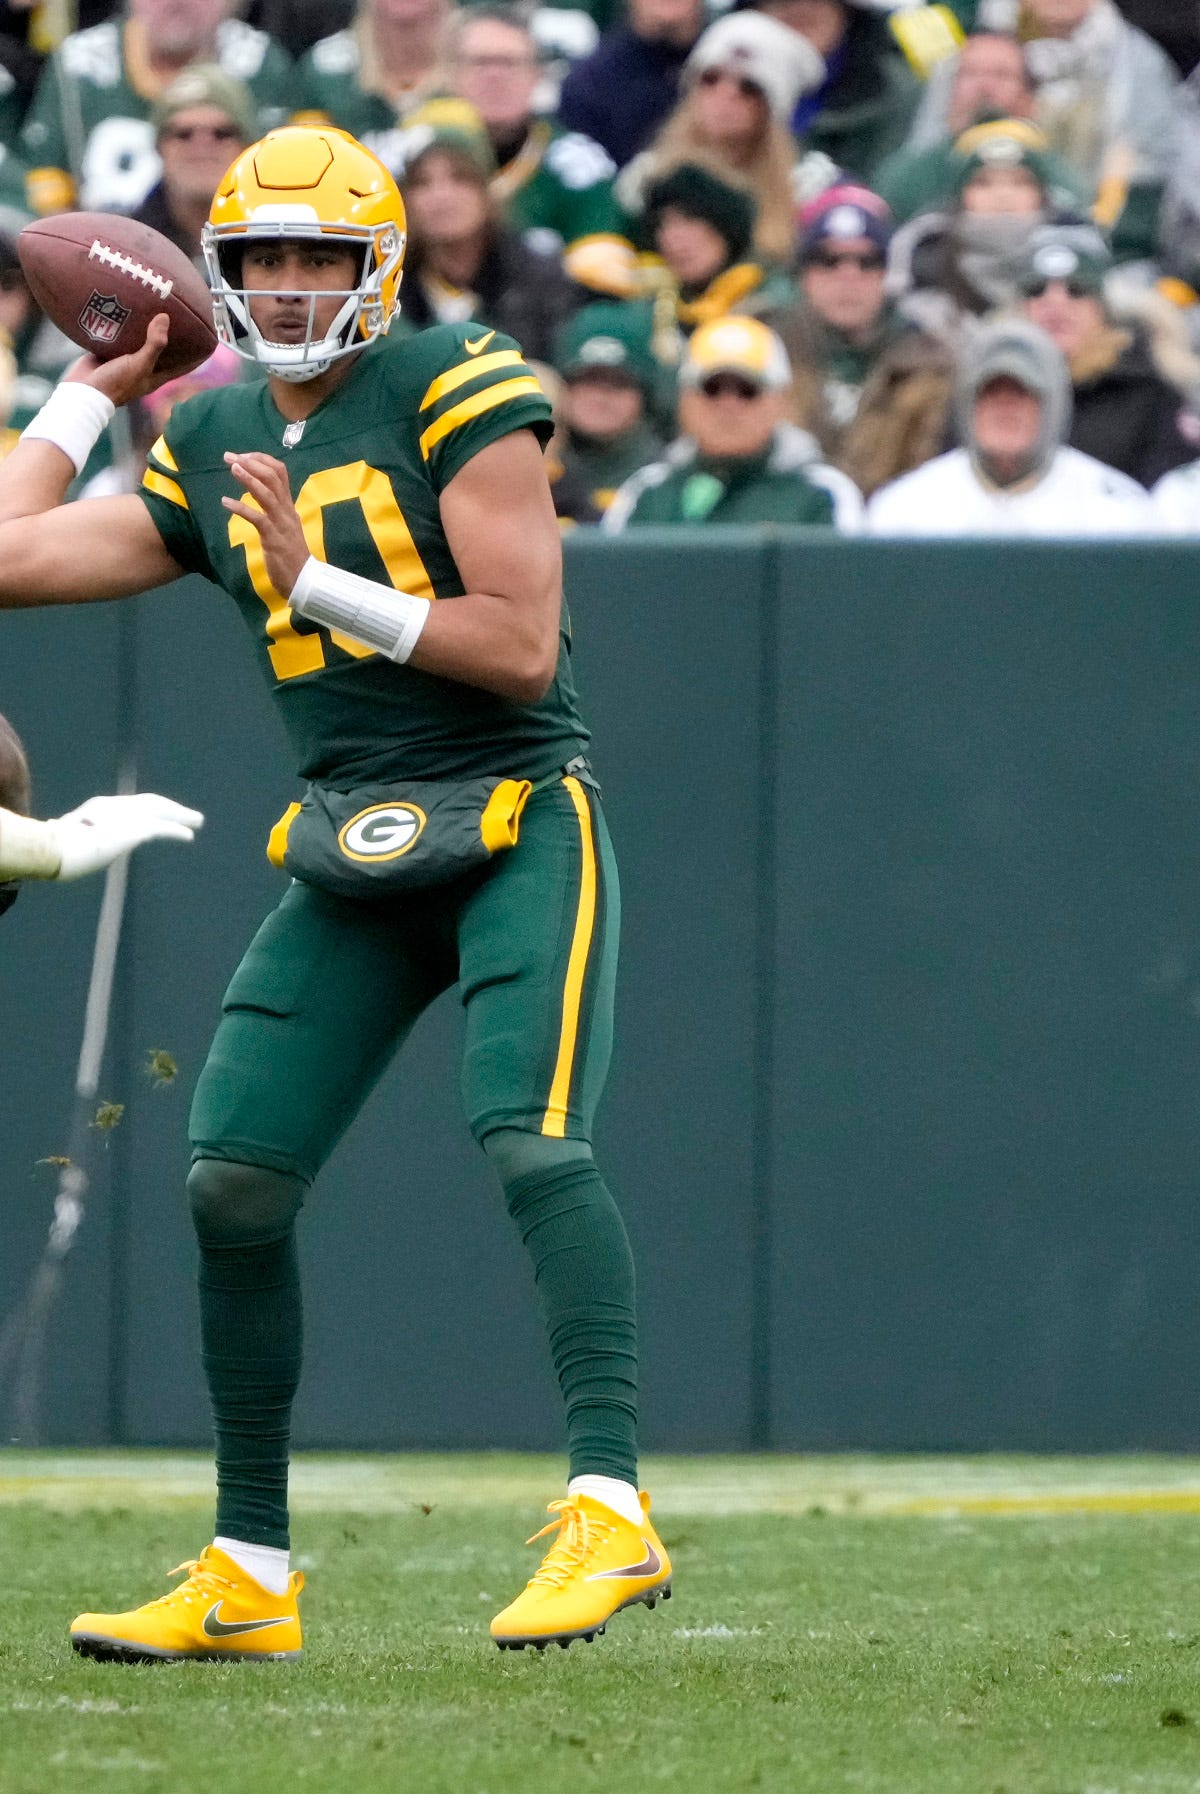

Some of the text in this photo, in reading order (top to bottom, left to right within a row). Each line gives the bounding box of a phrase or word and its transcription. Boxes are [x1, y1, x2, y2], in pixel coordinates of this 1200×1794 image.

[82, 308, 115, 338] NFL
[228, 460, 436, 680] 10
[345, 807, 420, 856] G
